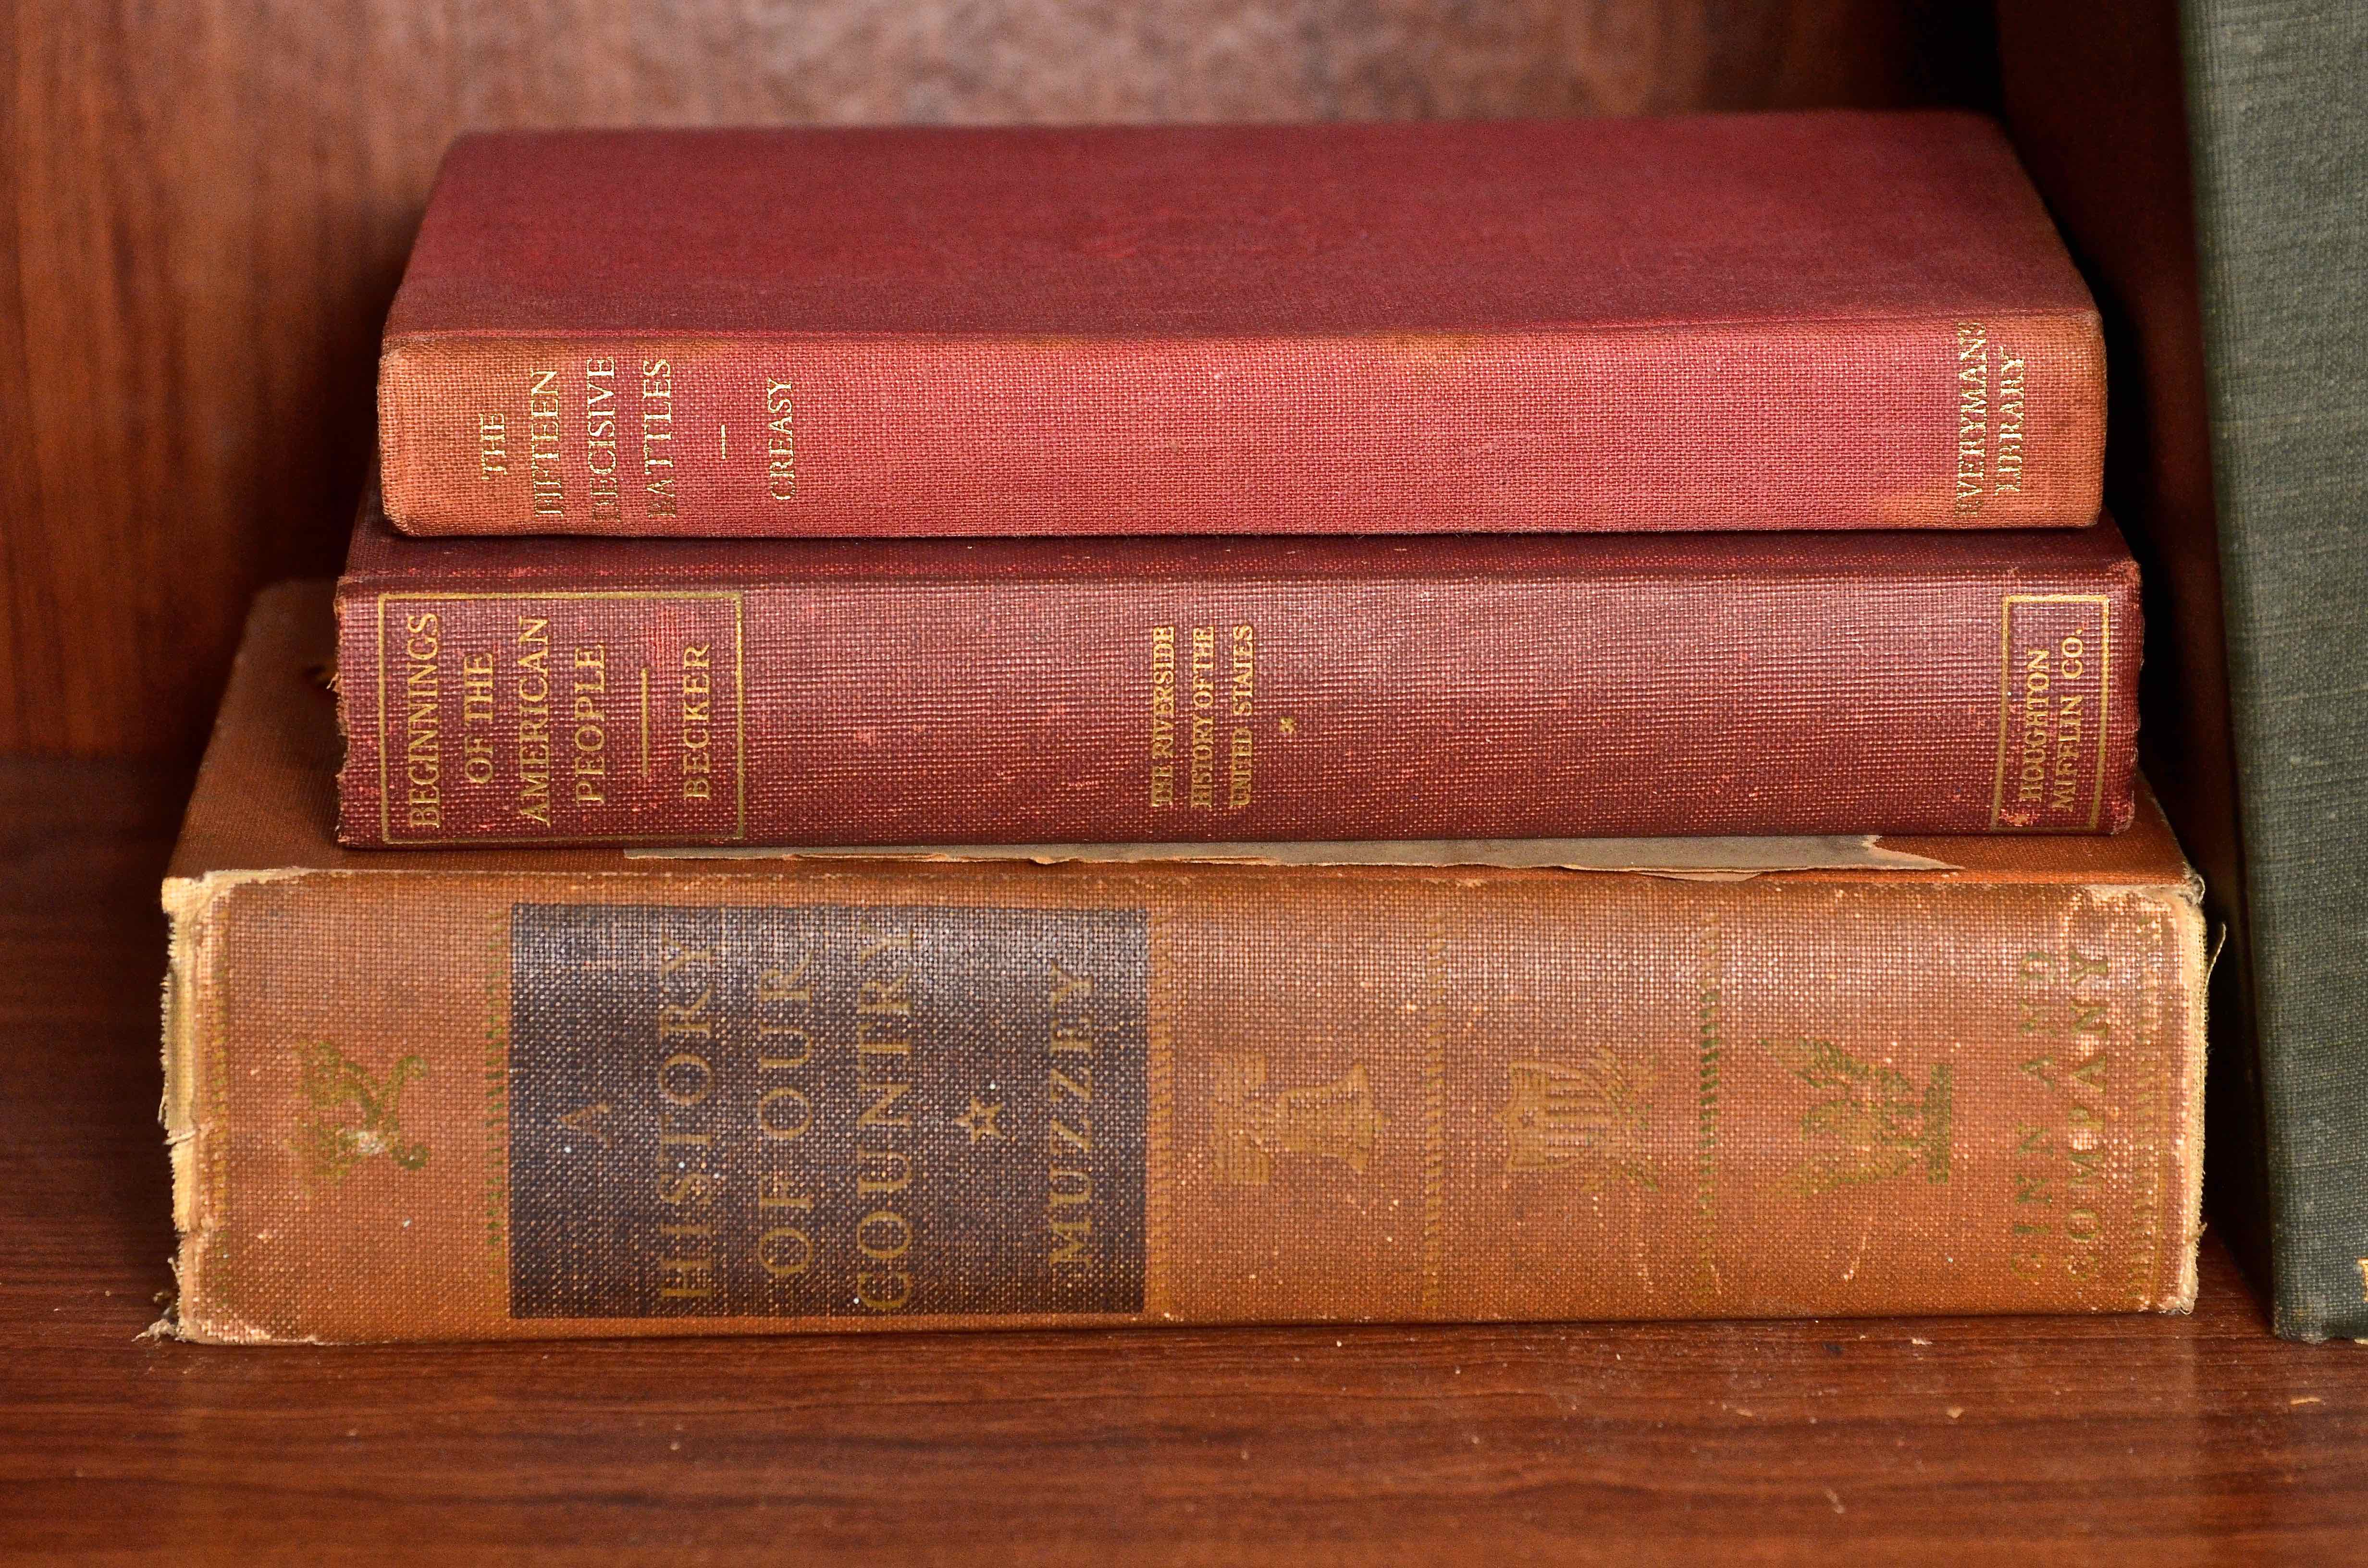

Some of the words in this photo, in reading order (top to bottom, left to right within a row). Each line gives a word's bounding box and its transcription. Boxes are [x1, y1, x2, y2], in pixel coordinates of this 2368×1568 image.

[480, 413, 507, 480] THE
[530, 368, 564, 517] FIFTEEN
[587, 356, 621, 522] DECISIVE
[643, 359, 677, 518] BATTLES
[768, 378, 796, 501] CREASY
[1993, 345, 2025, 496] LIBRARY
[464, 652, 493, 722] THE
[1152, 625, 1175, 759] RIVERSIDE
[1193, 625, 1214, 676] THE
[1193, 676, 1214, 708] OF
[1233, 625, 1253, 716] STATES
[2060, 628, 2084, 679] CO.
[407, 612, 440, 828] BEGINNINGS
[464, 734, 493, 784] OF
[518, 615, 550, 828] AMERICAN
[575, 644, 605, 804] PEOPLE
[683, 643, 710, 800] BECKER
[1151, 765, 1174, 807] THE
[1191, 712, 1214, 808] HISTORY
[1230, 728, 1253, 807] UNITED
[2019, 648, 2050, 802] HOUGHTON
[2052, 694, 2083, 812] MIFFLIN
[759, 950, 813, 1140] OUR
[557, 1102, 614, 1149] A
[658, 932, 715, 1299] HISTORY
[857, 924, 913, 1311] COUNTRY
[1049, 961, 1093, 1267] MUZZEY
[2064, 945, 2109, 1281] COMPANY
[759, 1172, 813, 1276] OF
